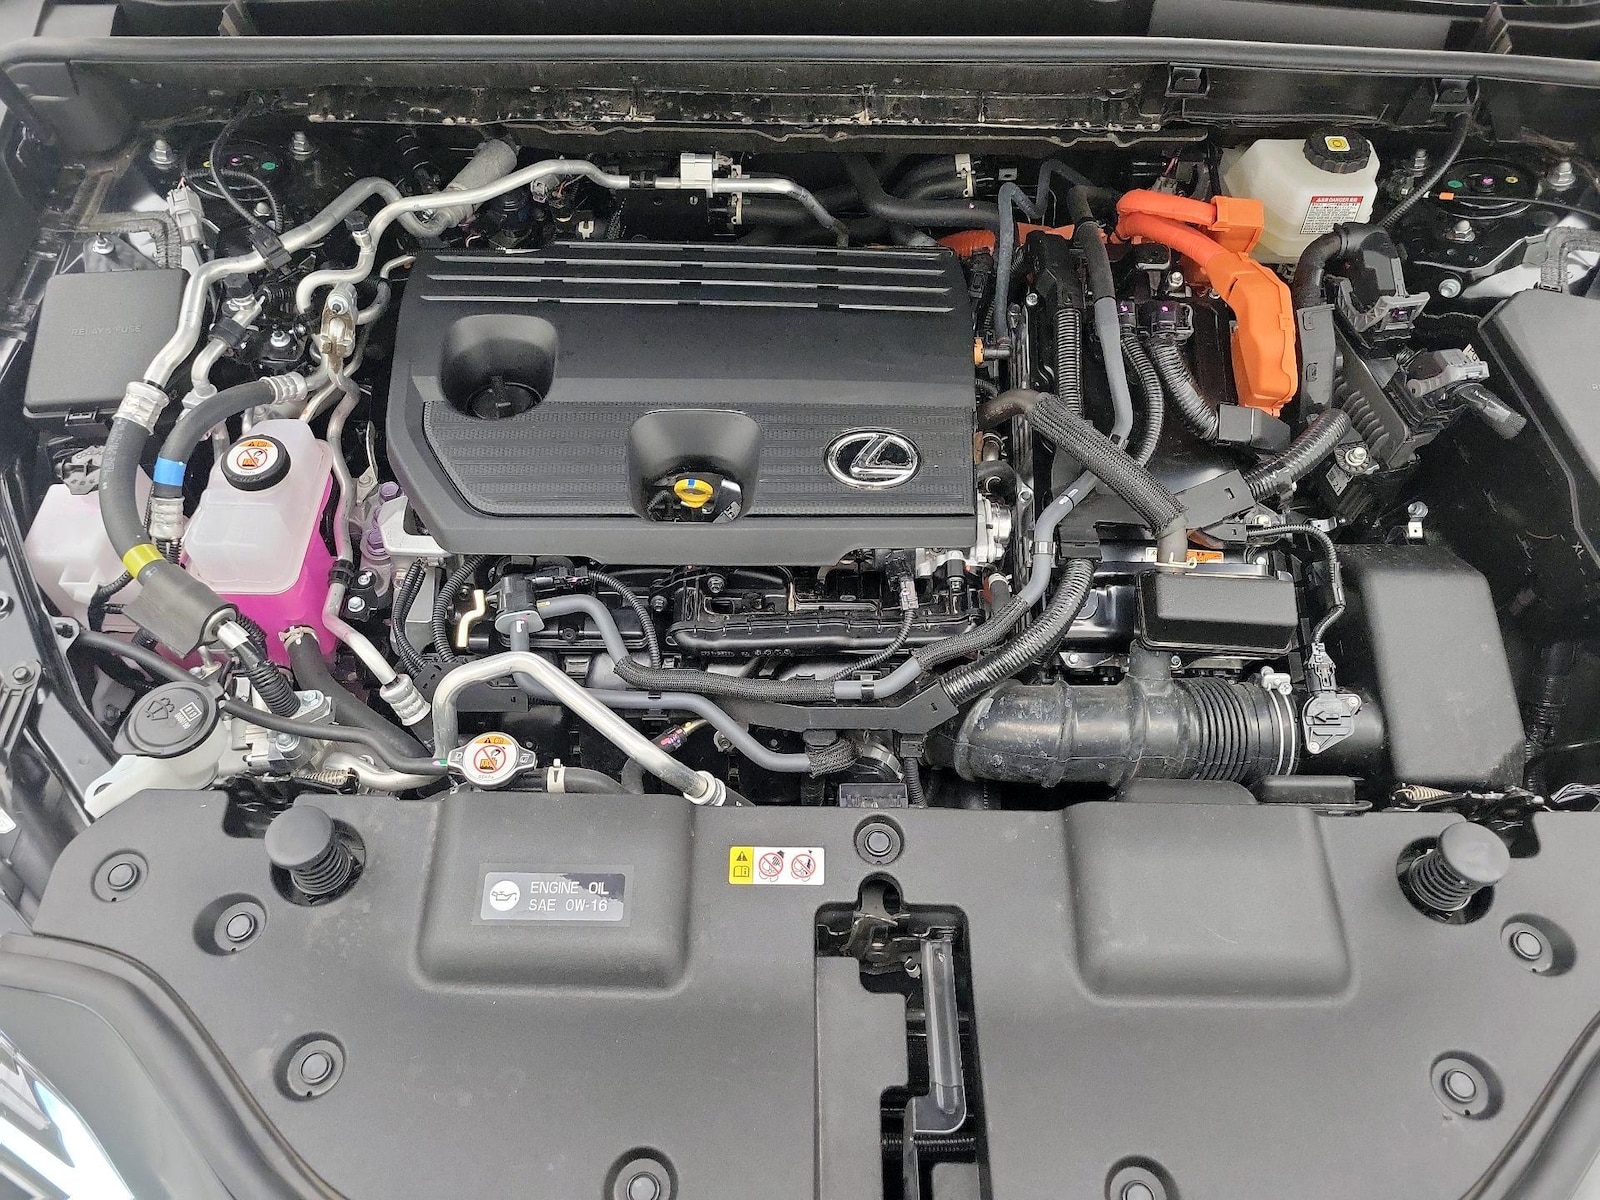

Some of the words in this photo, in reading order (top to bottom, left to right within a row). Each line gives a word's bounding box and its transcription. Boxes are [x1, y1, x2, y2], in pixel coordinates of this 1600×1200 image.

[530, 881, 580, 894] ENGINE
[588, 881, 610, 895] OIL
[528, 898, 557, 911] SAE
